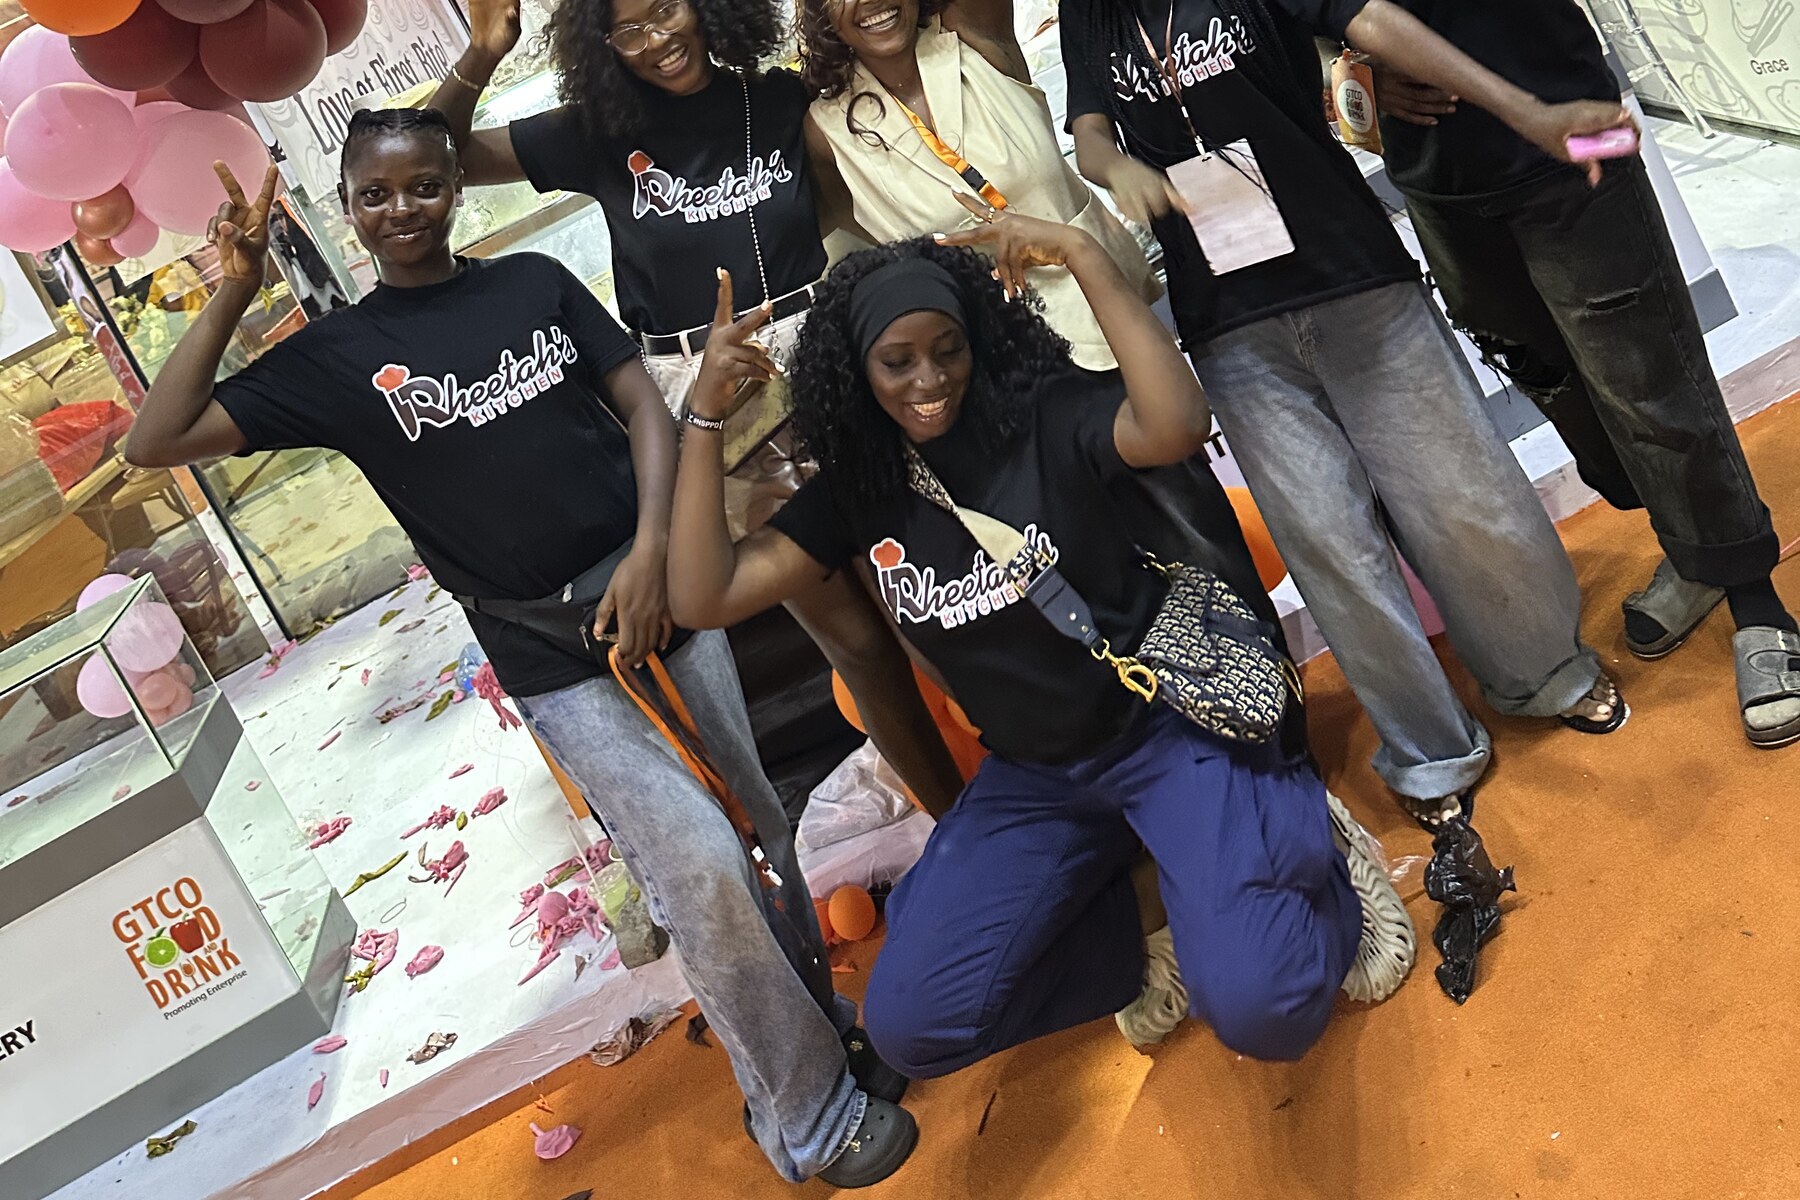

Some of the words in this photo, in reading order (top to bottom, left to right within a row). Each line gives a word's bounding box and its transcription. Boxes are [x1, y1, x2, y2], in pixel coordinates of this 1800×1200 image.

[369, 53, 420, 98] First
[1750, 57, 1790, 75] Grace
[633, 149, 793, 220] Rheetah's
[383, 326, 578, 441] Rheetah's
[468, 367, 565, 427] KITCHEN
[112, 876, 203, 944] GTCO
[145, 938, 241, 1010] DRINK
[203, 942, 218, 955] AND
[164, 993, 207, 1020] Promoting
[206, 970, 248, 997] Enterprise
